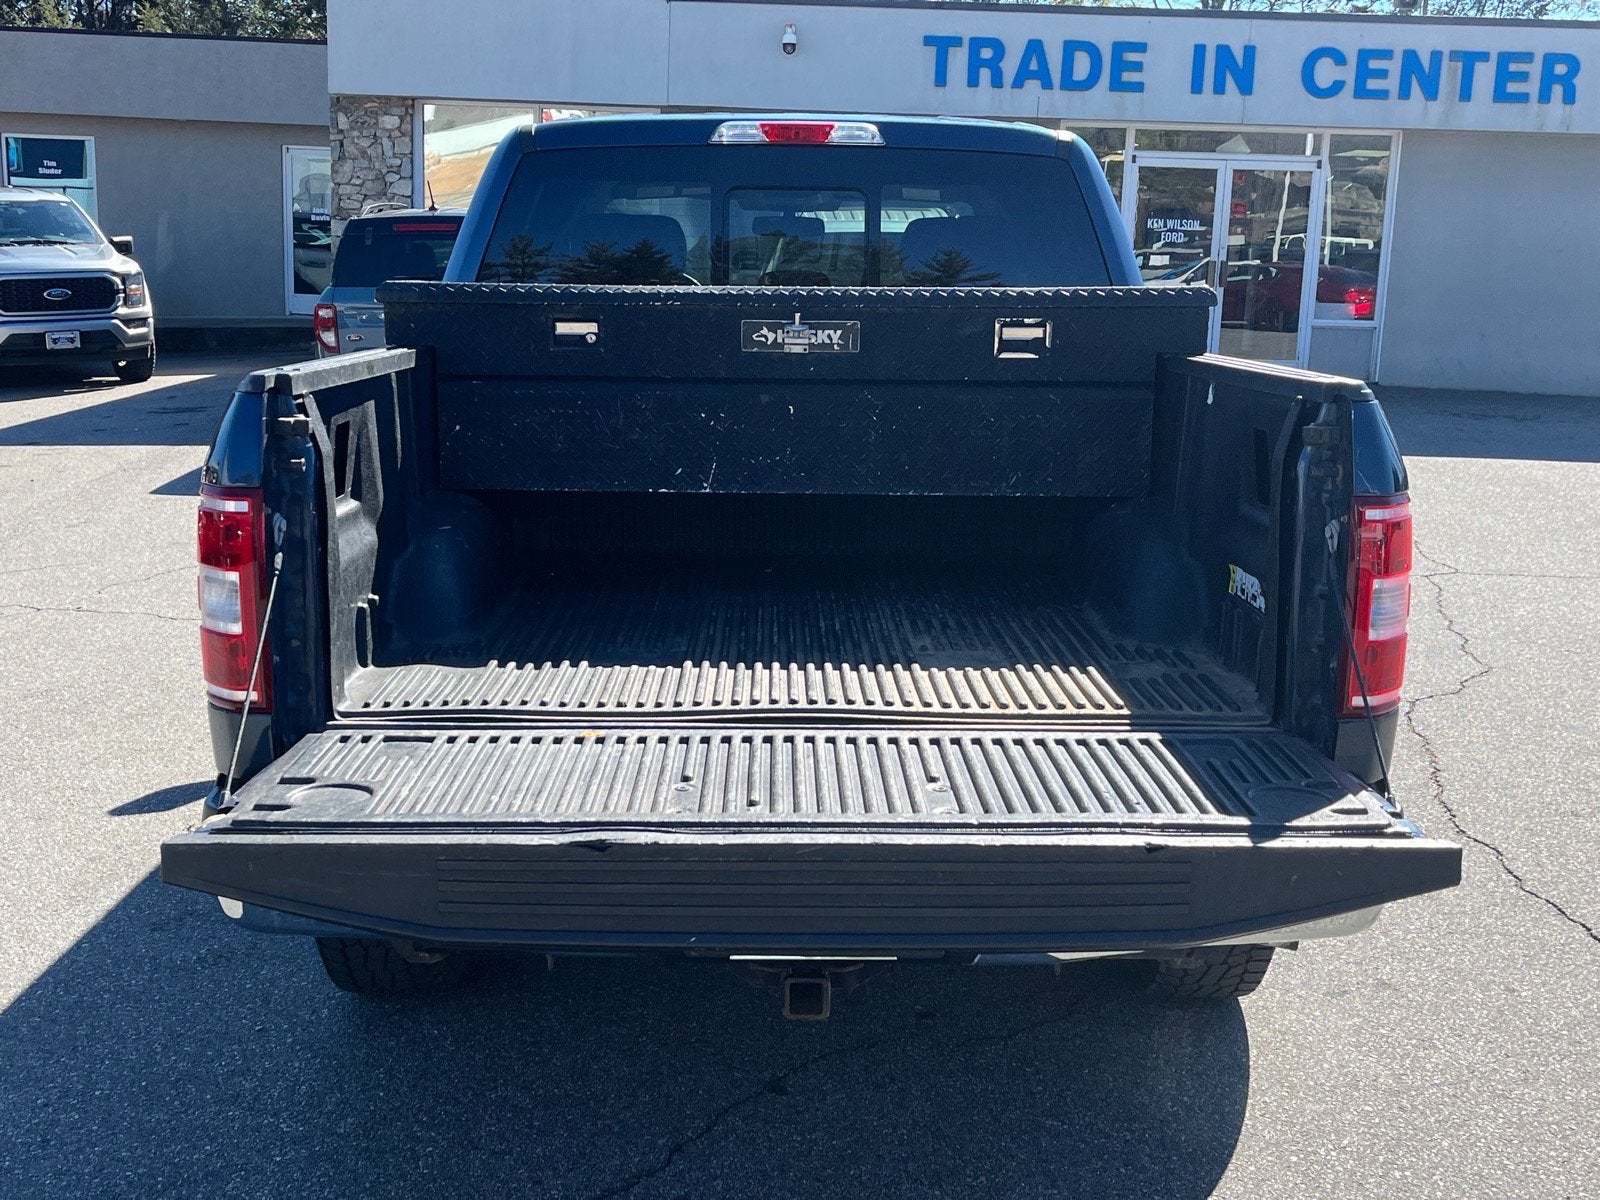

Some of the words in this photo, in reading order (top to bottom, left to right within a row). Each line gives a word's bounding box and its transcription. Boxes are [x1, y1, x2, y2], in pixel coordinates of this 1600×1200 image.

[923, 35, 1148, 93] TRADE
[1190, 43, 1256, 96] IN
[1301, 46, 1581, 105] CENTER
[1147, 218, 1164, 229] KEN
[1166, 219, 1200, 230] WILSON
[1161, 231, 1184, 243] FORD
[776, 329, 843, 344] HSKY
